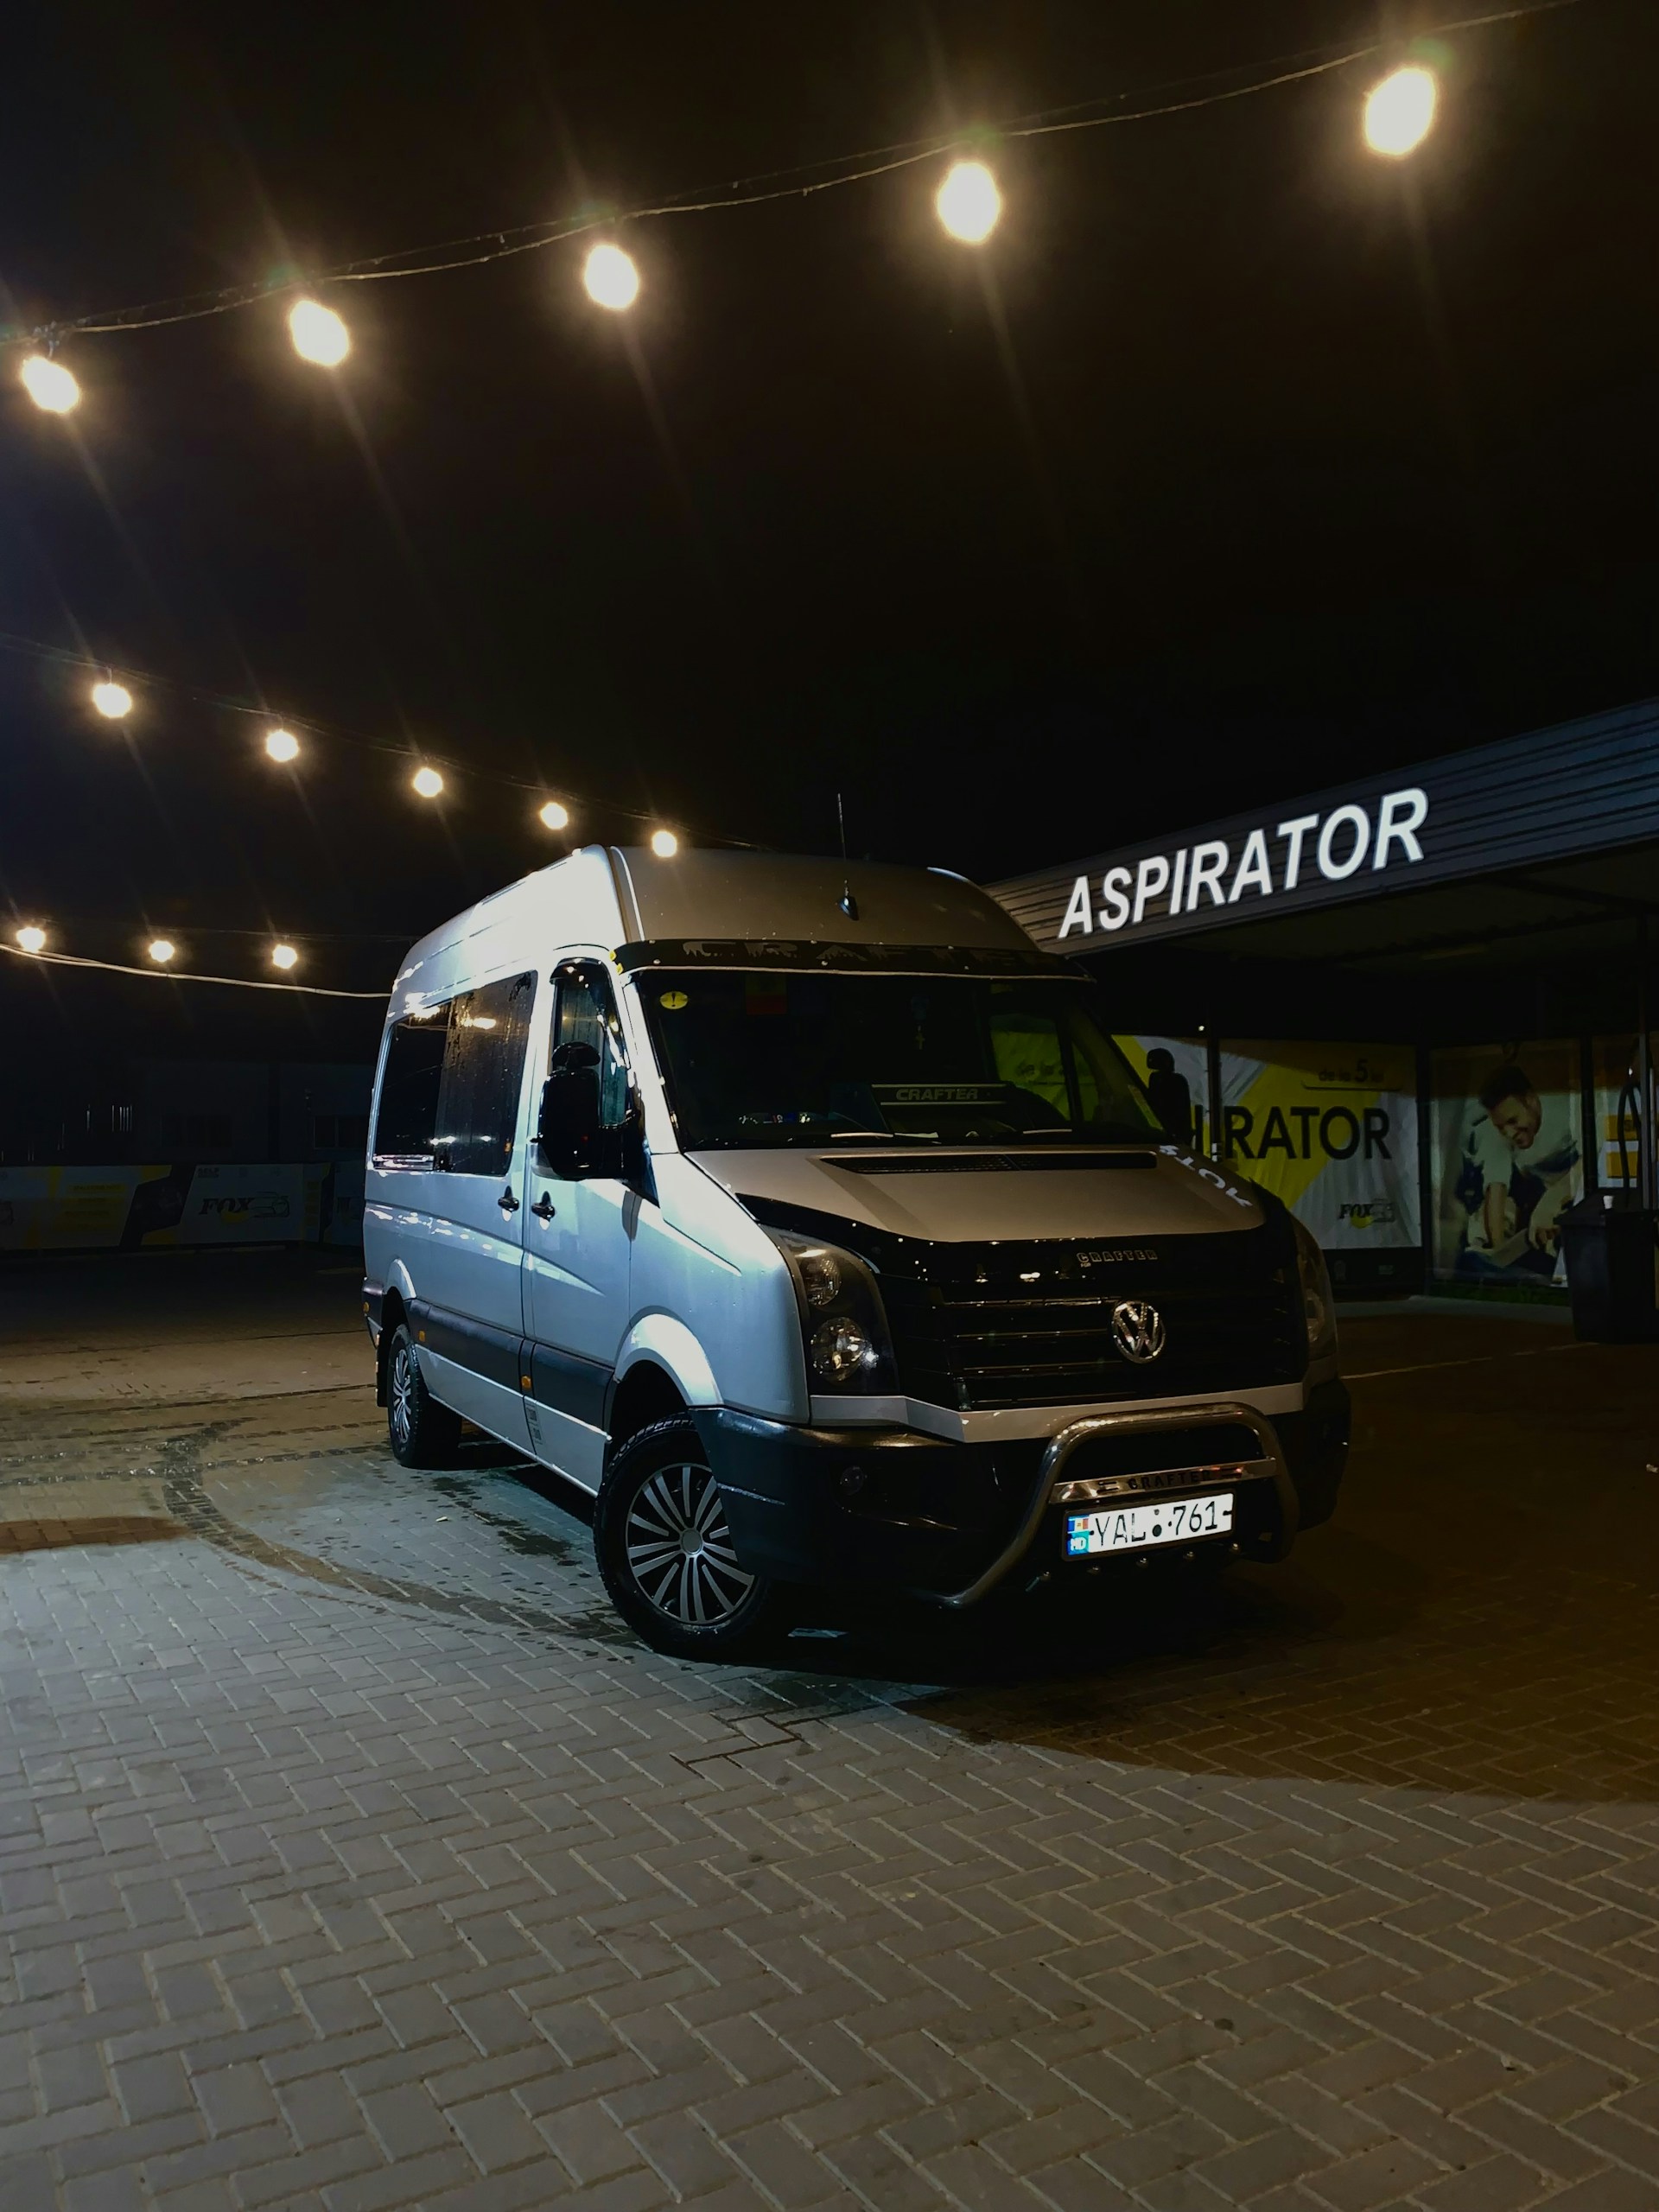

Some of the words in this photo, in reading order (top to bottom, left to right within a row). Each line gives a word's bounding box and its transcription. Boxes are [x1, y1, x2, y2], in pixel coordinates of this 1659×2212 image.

[1058, 786, 1429, 939] ASPIRATOR
[1354, 1058, 1369, 1082] 5
[895, 1088, 978, 1102] CRAFTER
[199, 1197, 255, 1215] FOX
[1338, 1203, 1375, 1219] FOX
[1076, 1249, 1159, 1263] CRAFTER
[1127, 1470, 1211, 1491] CRAFTER
